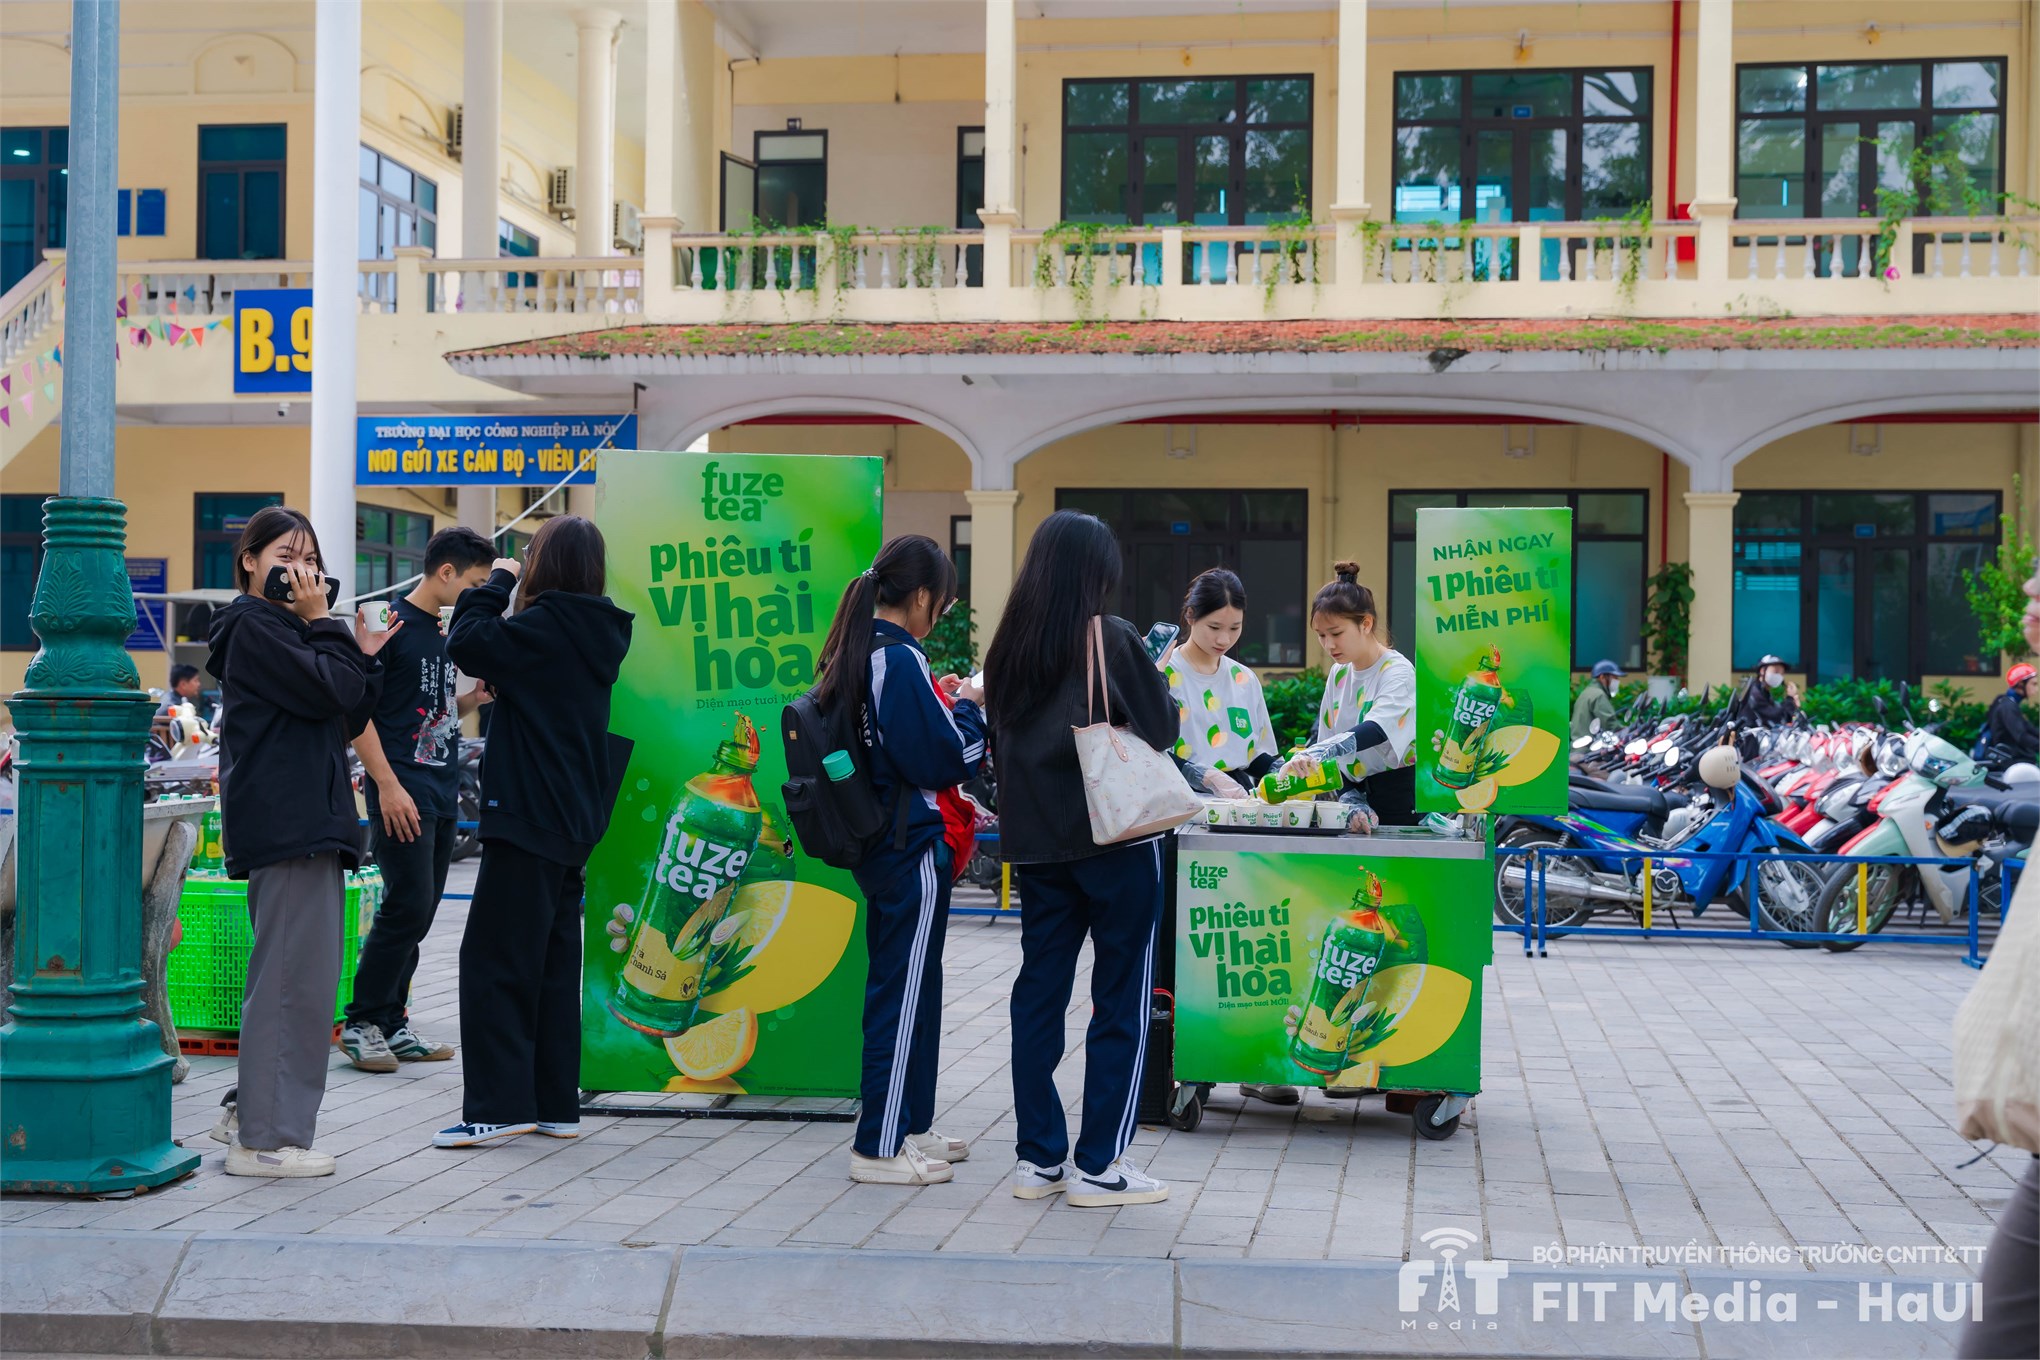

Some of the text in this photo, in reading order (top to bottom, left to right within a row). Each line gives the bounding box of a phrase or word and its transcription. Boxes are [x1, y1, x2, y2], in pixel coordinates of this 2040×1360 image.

[375, 421, 425, 438] TRƯỜNG
[428, 425, 451, 441] ĐẠI
[455, 425, 481, 441] HỌC
[484, 422, 519, 438] CÔNG
[521, 422, 569, 440] NGHIỆP
[571, 421, 590, 437] HÀ
[368, 448, 397, 472] NƠI
[402, 438, 432, 472] GỬI
[437, 449, 458, 472] XE
[463, 442, 498, 472] CÁN
[538, 443, 574, 472] VIÊN
[702, 462, 784, 497] fuze
[702, 494, 763, 522] tea
[779, 527, 814, 572] tí
[1433, 532, 1555, 562] NHẬN NGAY
[1427, 575, 1443, 602] 1
[1535, 557, 1560, 590] tí
[648, 580, 815, 640] vị hài
[1436, 598, 1550, 634] MIỄN PHÍ
[693, 634, 815, 692] hòa
[696, 698, 724, 711] Diện
[727, 697, 752, 710] mạo
[1453, 706, 1482, 728] tea
[1456, 688, 1496, 718] fuze
[664, 813, 748, 878] fuze
[655, 851, 718, 900] tea
[1189, 861, 1228, 878] fuze
[1189, 876, 1220, 890] tea
[1269, 898, 1291, 927] tí
[1189, 930, 1292, 966] vị hài
[1323, 934, 1377, 975] fuze
[1216, 963, 1292, 998] hòa
[1318, 959, 1358, 989] tea
